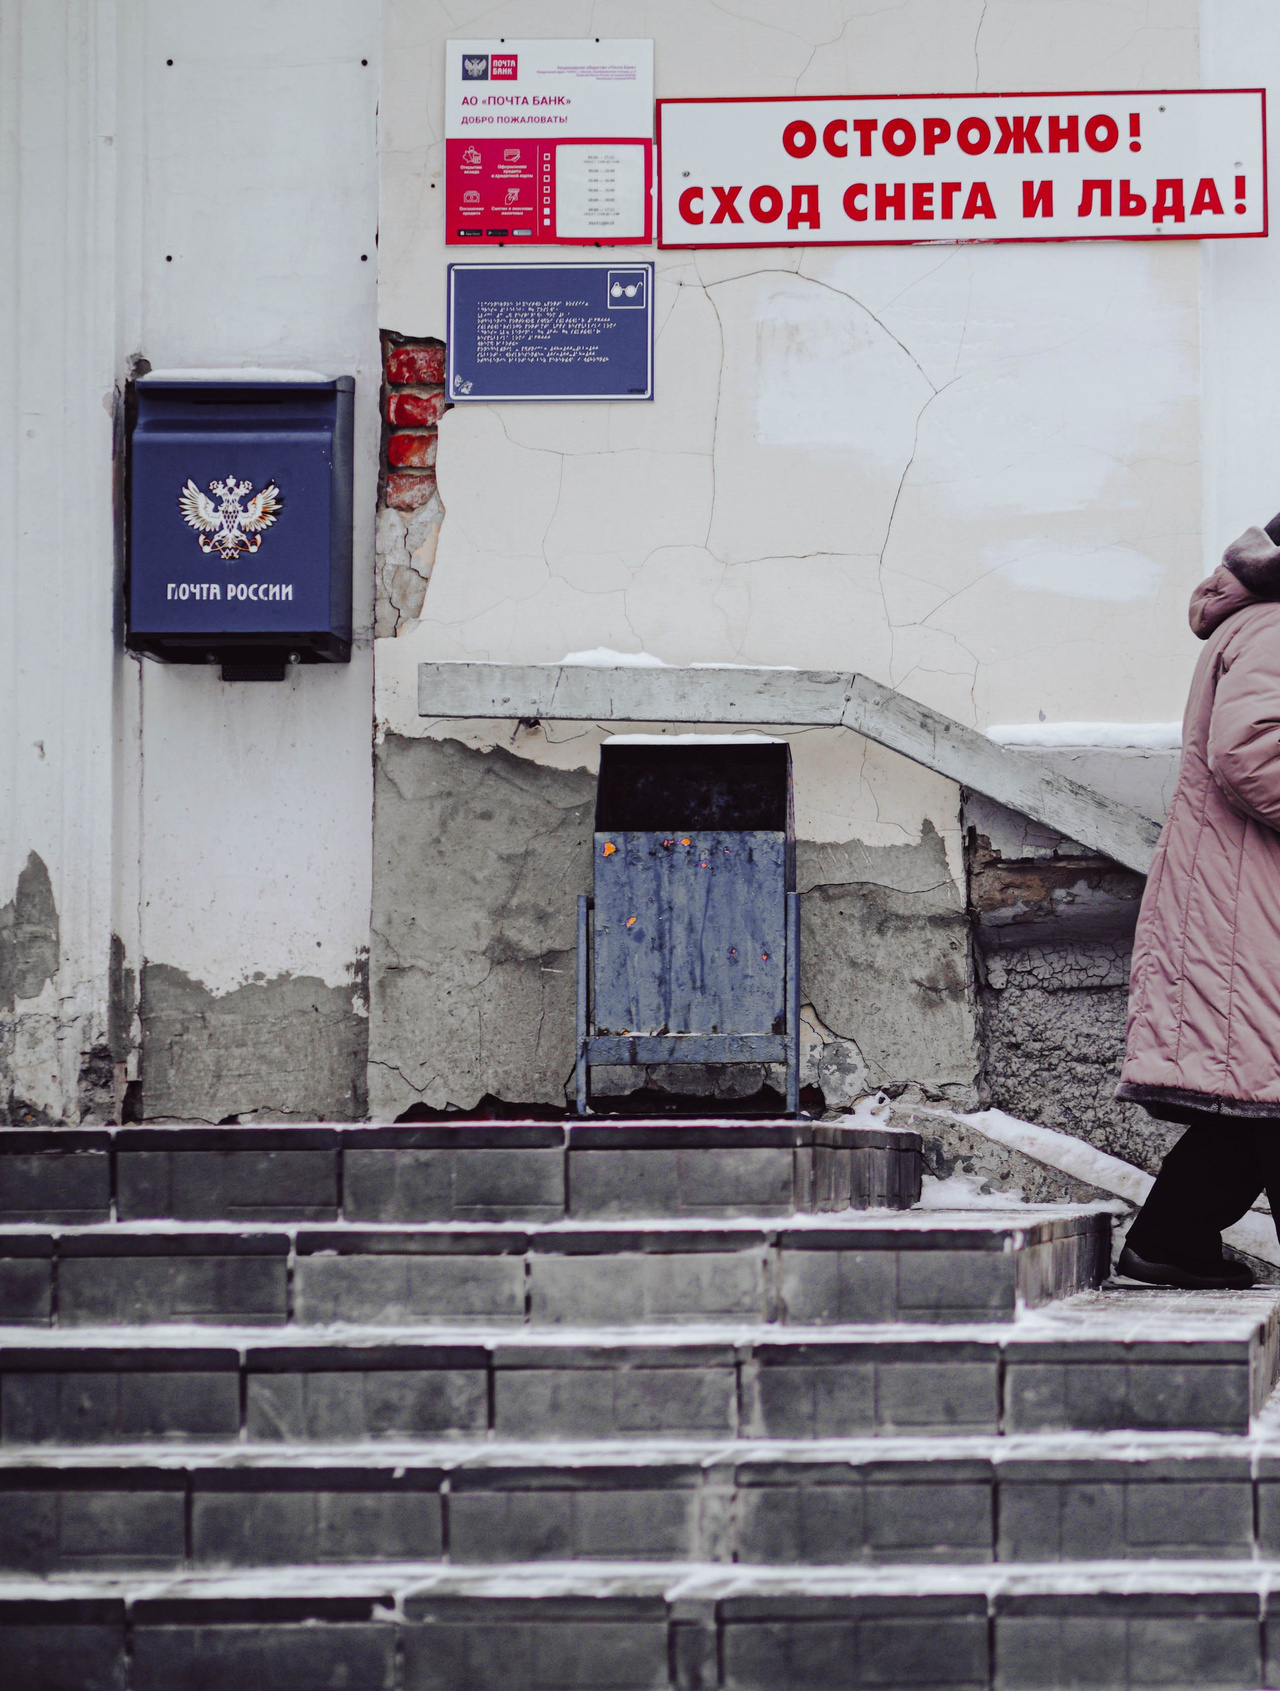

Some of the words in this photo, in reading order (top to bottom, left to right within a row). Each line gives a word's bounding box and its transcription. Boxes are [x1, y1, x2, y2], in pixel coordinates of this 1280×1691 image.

[493, 59, 516, 67] ПОЧТА
[461, 96, 478, 106] АО
[482, 96, 529, 106] «ПОЧТА
[532, 96, 571, 106] БАНК»
[461, 116, 494, 125] ДОБРО
[496, 116, 568, 124] ПОЖАЛОВАТЬ!
[782, 113, 1141, 159] ОСТОРОЖНО!
[679, 185, 820, 229] СХОД
[843, 182, 996, 221] СНЕГА
[1022, 180, 1053, 218] И
[1078, 176, 1246, 223] ЛЬДА!
[167, 584, 221, 600] ПОЧТА
[227, 584, 292, 600] РОССИИ
